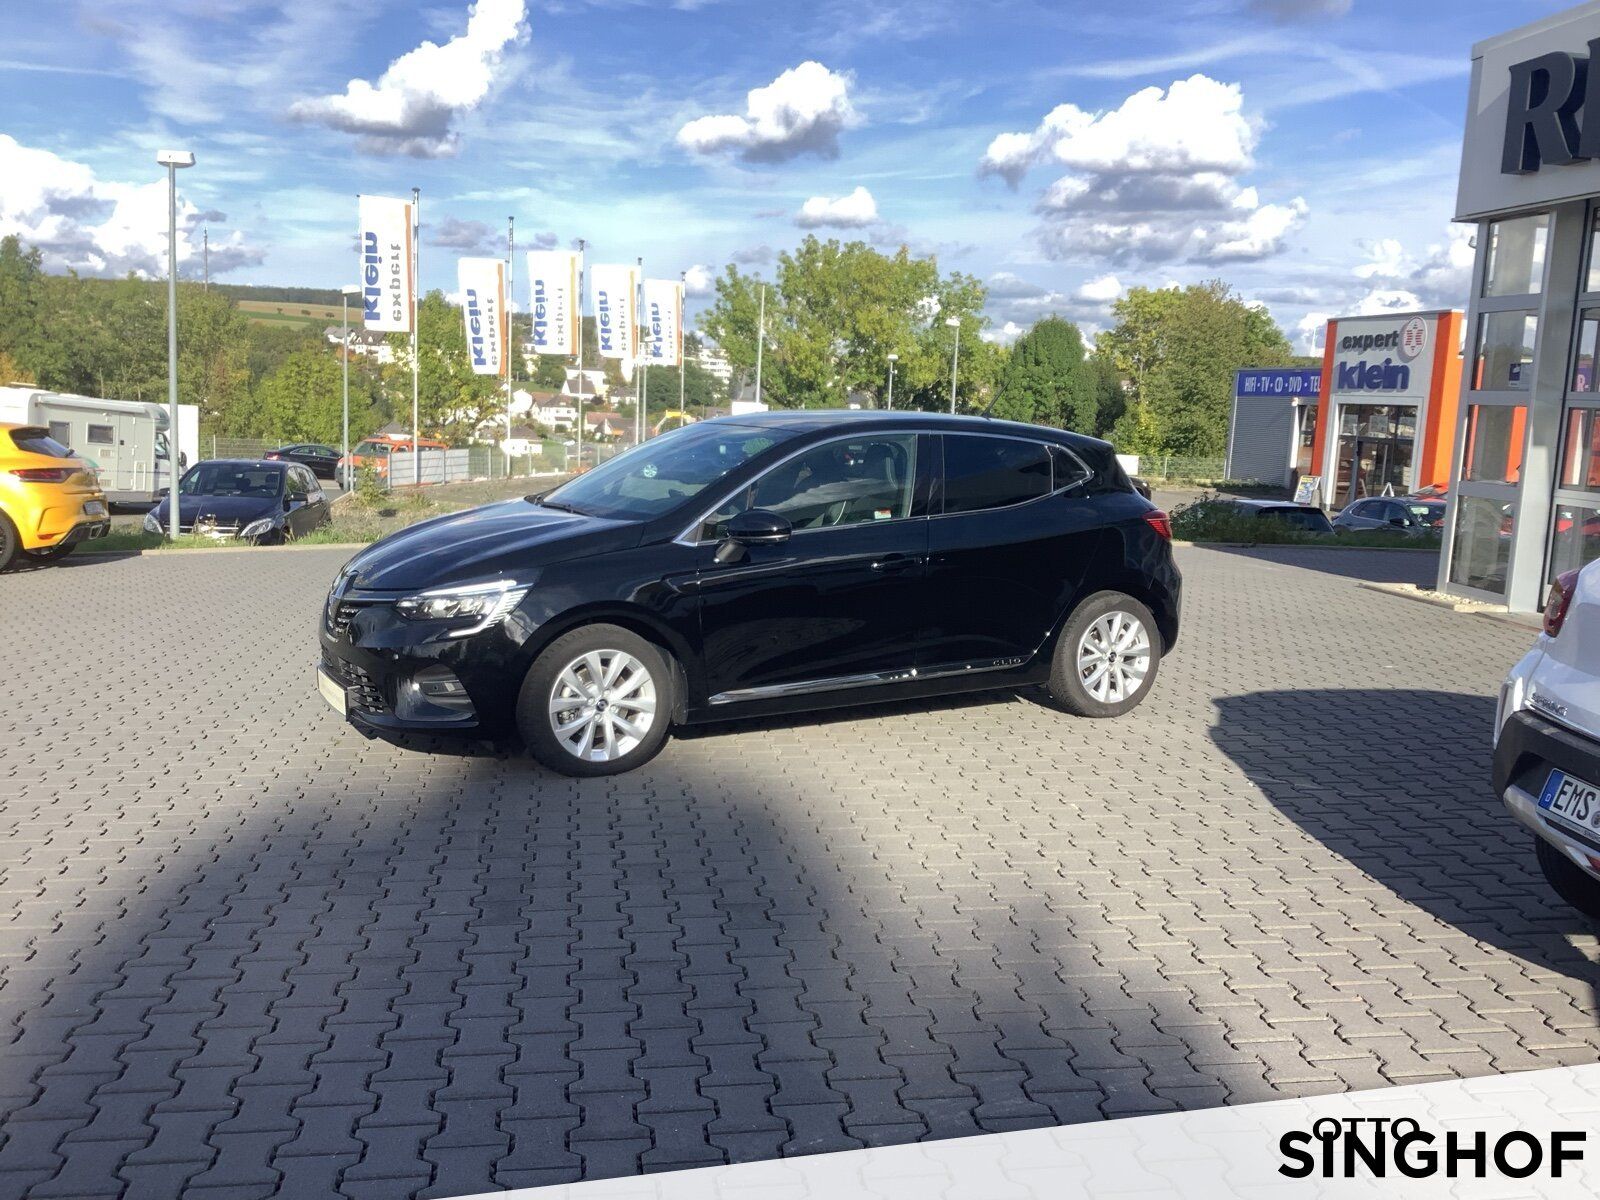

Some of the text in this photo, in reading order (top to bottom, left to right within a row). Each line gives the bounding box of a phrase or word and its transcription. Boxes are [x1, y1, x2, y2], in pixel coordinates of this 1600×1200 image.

[1342, 330, 1399, 351] expert
[1261, 377, 1271, 392] TV
[1275, 376, 1284, 392] CD
[1288, 376, 1303, 392] DVD
[1338, 358, 1410, 389] klein
[1553, 780, 1597, 821] EMS
